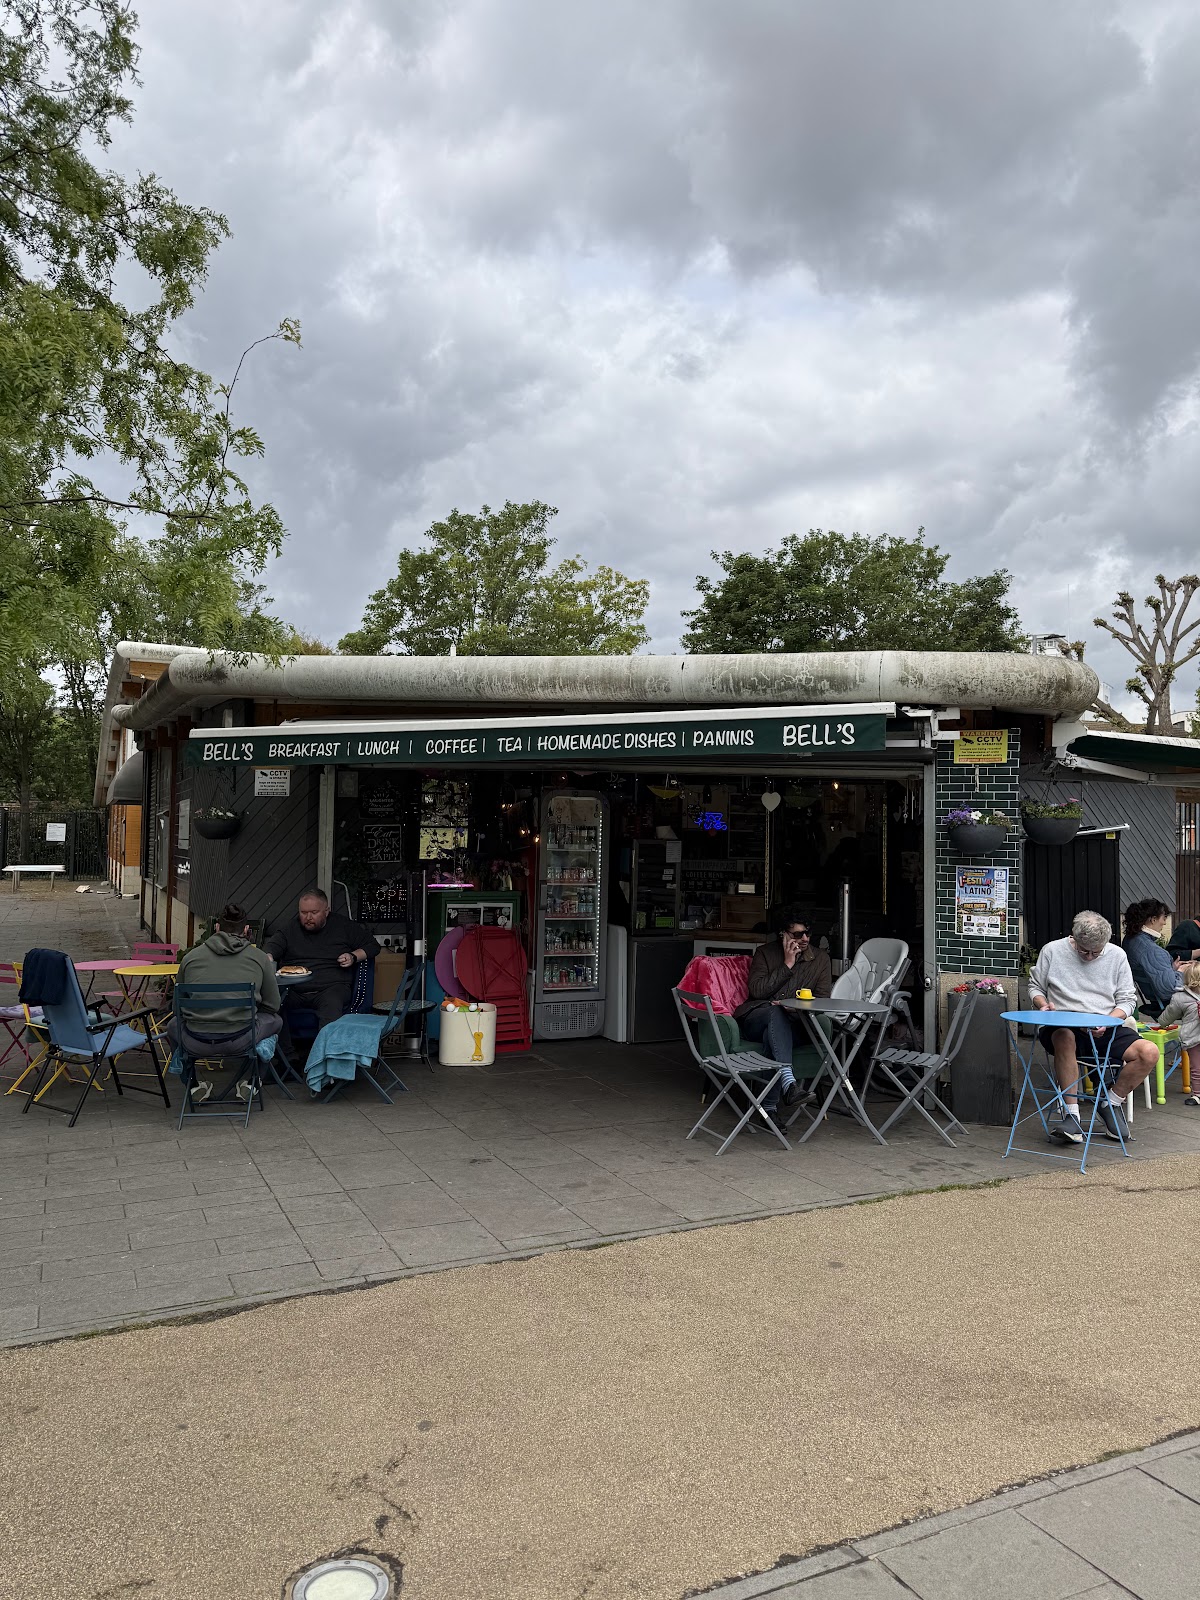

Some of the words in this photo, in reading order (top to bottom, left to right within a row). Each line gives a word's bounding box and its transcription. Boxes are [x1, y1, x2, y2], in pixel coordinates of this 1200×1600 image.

[202, 742, 254, 761] BELL'S
[268, 742, 341, 758] BREAKFAST
[357, 741, 400, 756] LUNCH
[425, 738, 478, 755] COFFEE
[496, 737, 523, 753] TEA
[537, 734, 622, 751] HOMEMADE
[624, 732, 677, 749] DISHES
[692, 729, 755, 747] PANINIS
[782, 722, 856, 747] BELL'S
[371, 827, 393, 838] Eat
[368, 837, 399, 848] DRINK
[959, 876, 994, 887] FESTIVAL
[964, 886, 992, 895] LATINO
